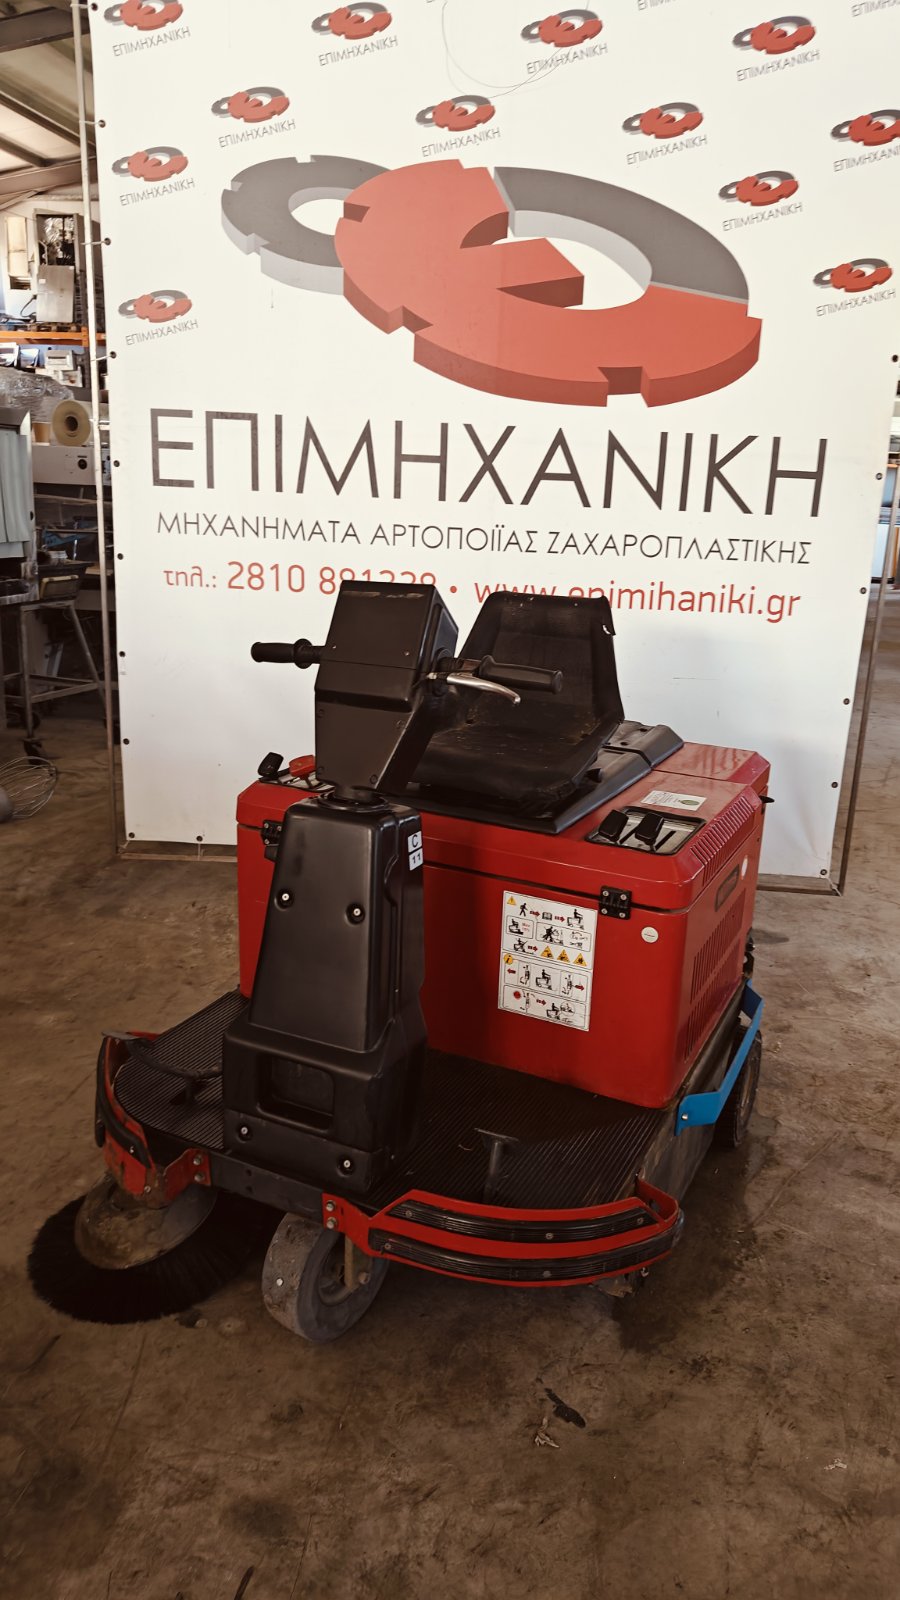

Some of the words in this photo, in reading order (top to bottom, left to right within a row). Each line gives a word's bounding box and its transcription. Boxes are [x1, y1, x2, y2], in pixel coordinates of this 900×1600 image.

[112, 26, 191, 56] ΕΠΙΜΗΧΑΝΙΚΗ
[318, 35, 399, 66] ΕΠΙΜΗΧΑΝΙΚΗ
[526, 43, 608, 75] ΕΠΙΜΗΧΑΝΙΚΗ
[736, 50, 820, 81] ΕΠΙΜΗΧΑΝΙΚΗ
[218, 119, 296, 147] ΕΠΙΜΗΧΑΝΙΚΗ
[421, 128, 501, 157] ΕΠΙΜΗΧΑΝΙΚΗ
[626, 134, 708, 165] ΕΠΙΜΗΧΑΝΙΚΗ
[119, 178, 195, 206] ΕΠΙΜΗΧΑΝΙΚΗ
[722, 202, 803, 231] ΕΠΙΜΗΧΑΝΙΚΗ
[816, 288, 897, 316] ΕΠΙΜΗΧΑΝΙΚΗ
[125, 319, 199, 345] ΕΠΙΜΗΧΑΝΙΚΗ
[150, 407, 827, 518] ΕΠΙΜΗΧΑΝΙΚΗ
[157, 512, 361, 545] ΜΗΧΑΝΗΜΑΤΑ
[370, 523, 538, 553] ΑΡΤΟΠΟΙΪΑΣ
[547, 531, 812, 565] ΖΑΧΑΡΟΠΛΑΣΤΙΚΗΣ
[227, 561, 305, 593] 2810
[474, 580, 801, 623] weimihaniki.gr
[411, 834, 419, 848] C
[412, 852, 421, 864] 11
